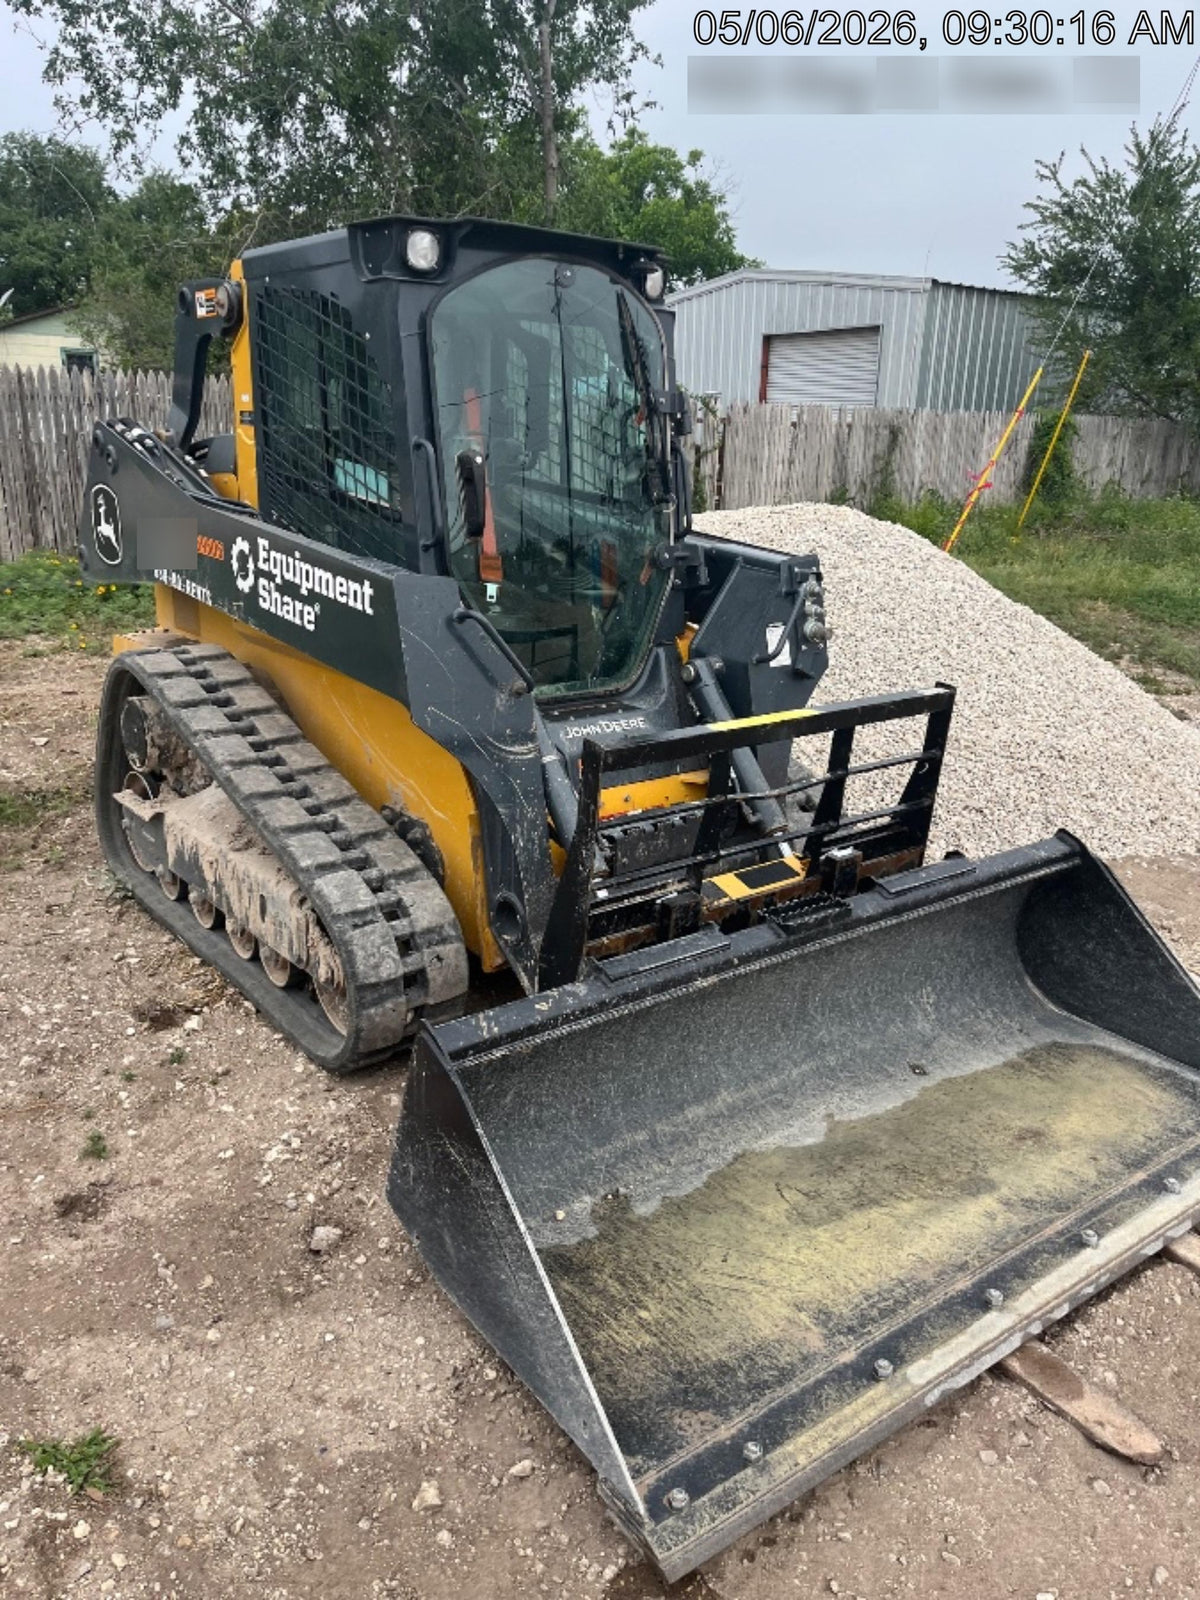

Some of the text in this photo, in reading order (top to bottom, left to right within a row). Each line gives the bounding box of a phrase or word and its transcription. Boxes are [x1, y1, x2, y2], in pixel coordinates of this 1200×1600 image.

[257, 536, 374, 615] Equipment
[566, 717, 647, 739] JOHN DEERE
